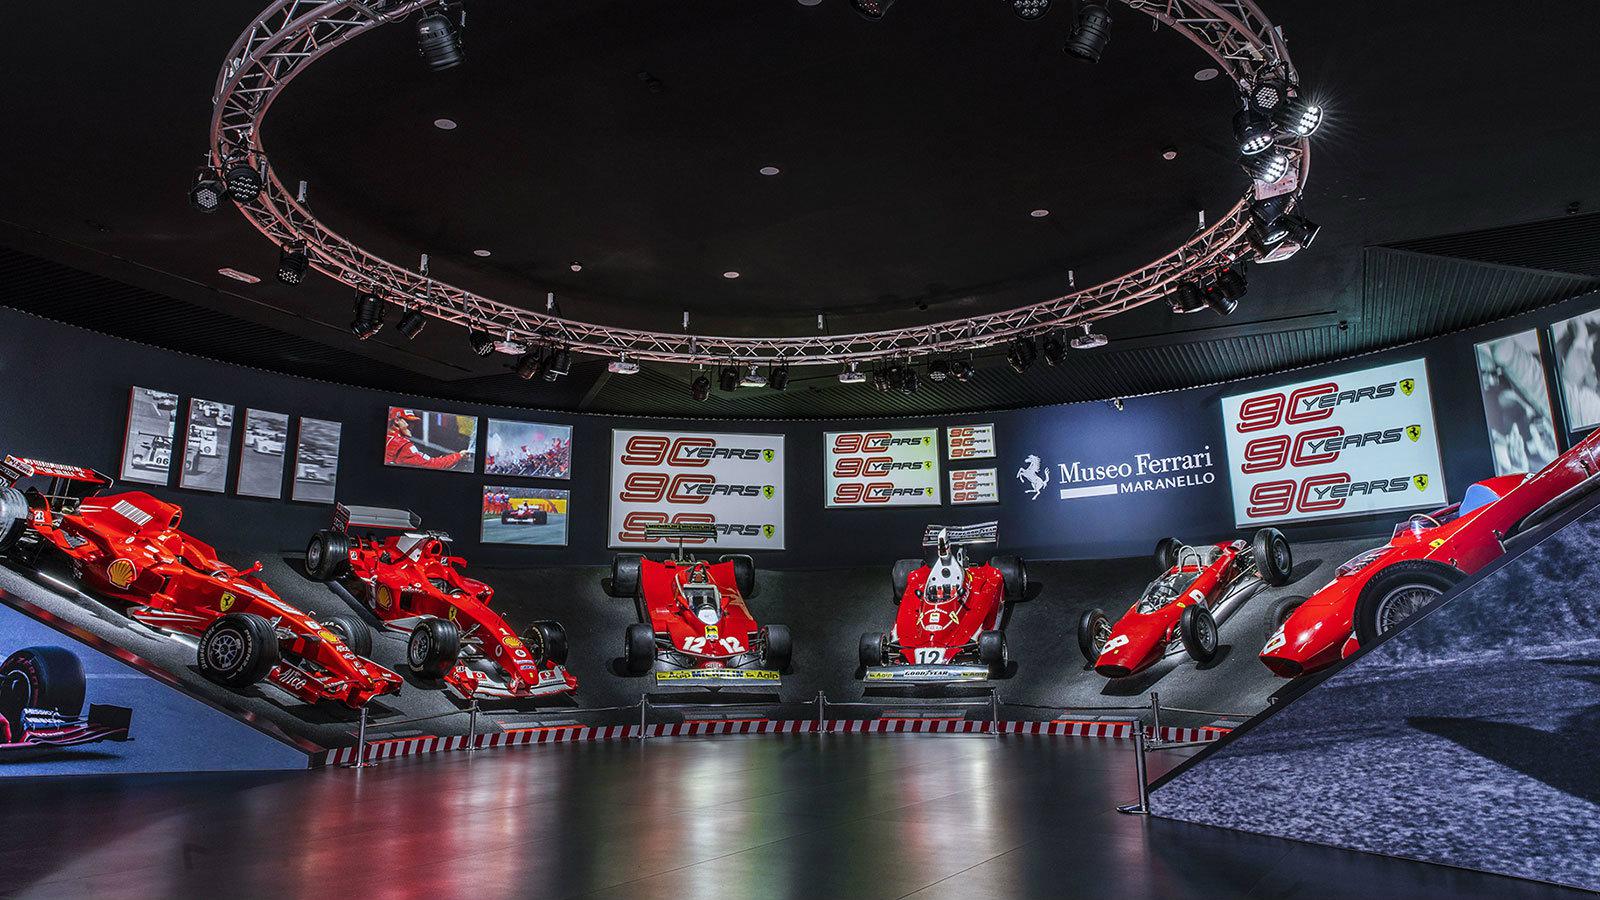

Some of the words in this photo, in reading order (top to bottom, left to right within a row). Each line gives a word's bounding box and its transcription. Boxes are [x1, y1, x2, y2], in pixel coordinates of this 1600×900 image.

[1236, 382, 1339, 433] 90
[1302, 381, 1398, 411] YEARS
[621, 436, 716, 467] 90
[684, 446, 761, 460] YEARS
[832, 432, 893, 454] 90
[871, 437, 922, 447] YEARS
[1241, 425, 1345, 474] 90
[1307, 427, 1404, 453] YEARS
[832, 457, 893, 478] 90
[872, 461, 923, 471] YEARS
[1058, 461, 1132, 484] Museo
[1134, 445, 1214, 476] Ferrari
[619, 472, 716, 504] 90
[683, 483, 761, 496] YEARS
[833, 482, 894, 504] 90
[872, 487, 924, 497] YEARS
[1120, 472, 1215, 494] MARANELLO
[1246, 472, 1351, 518] 90
[1313, 476, 1411, 500] YEARS
[682, 636, 706, 653] 12
[719, 636, 745, 653] 12
[919, 650, 941, 665] 12
